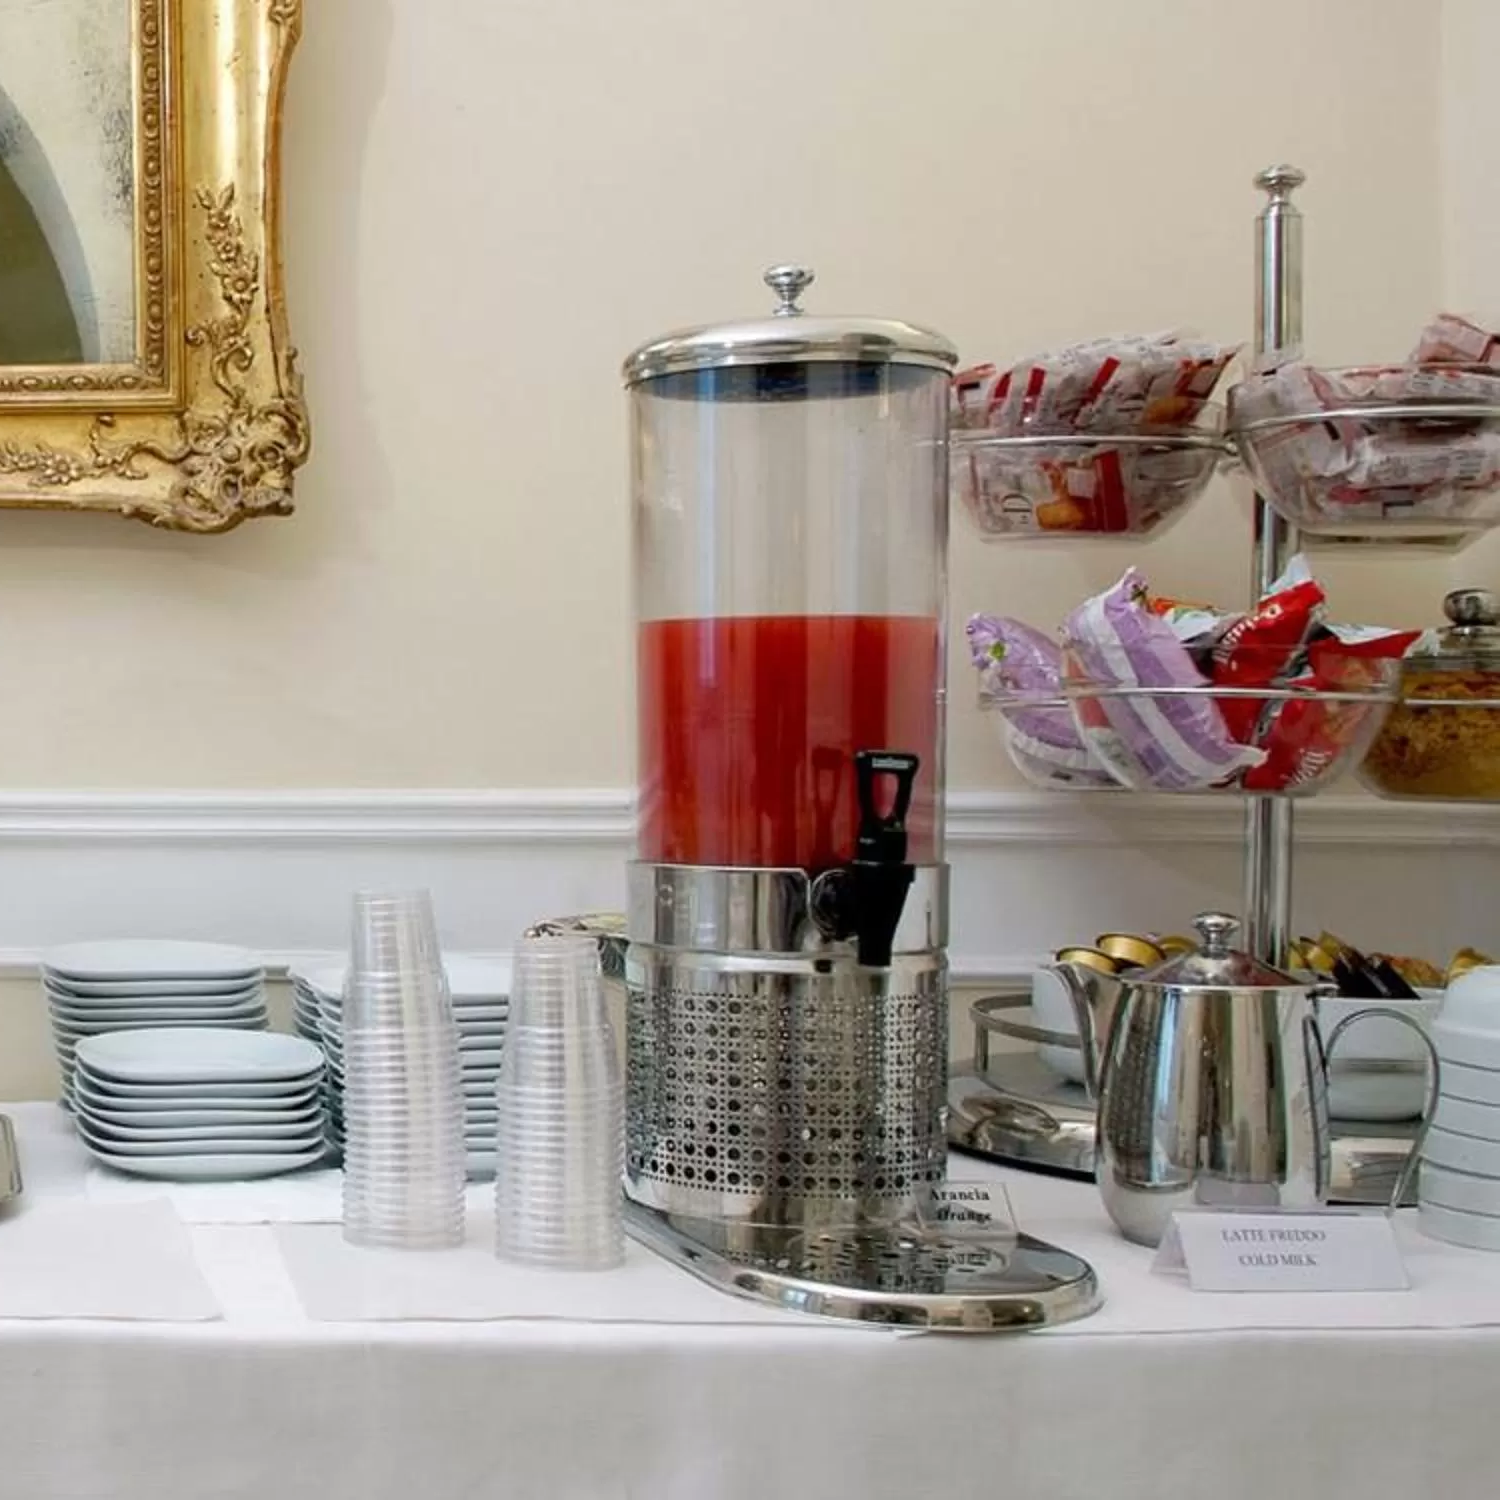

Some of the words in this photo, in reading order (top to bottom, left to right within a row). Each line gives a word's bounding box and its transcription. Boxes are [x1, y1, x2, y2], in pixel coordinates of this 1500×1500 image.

[1220, 1229, 1264, 1242] LATTE
[1238, 1254, 1278, 1266] COLD
[1280, 1254, 1317, 1266] MILK
